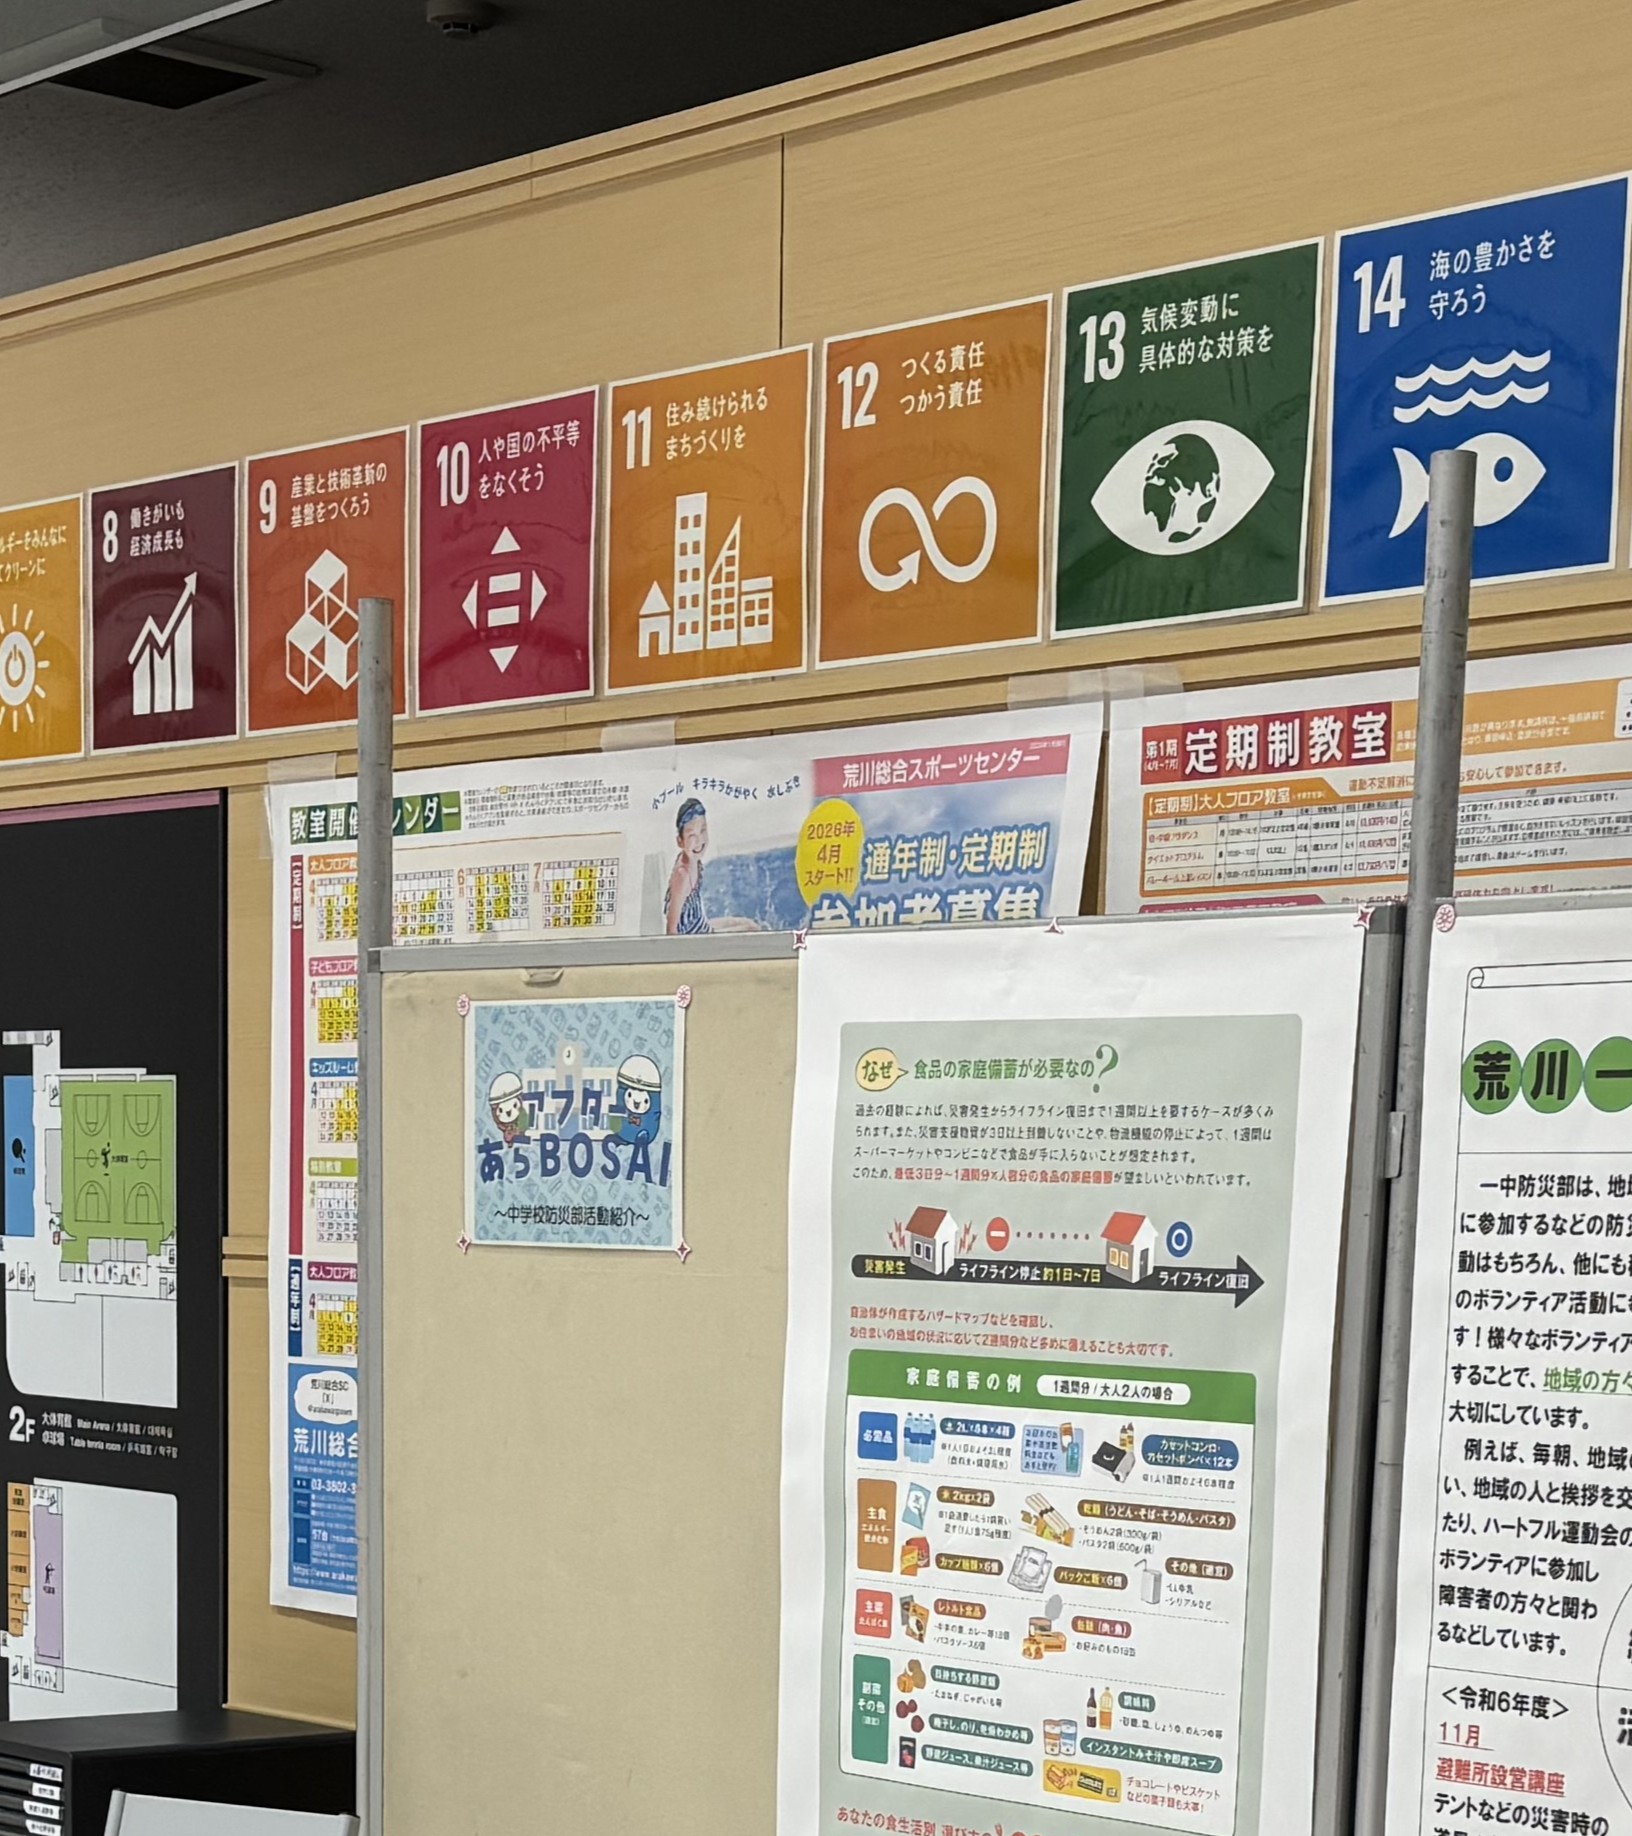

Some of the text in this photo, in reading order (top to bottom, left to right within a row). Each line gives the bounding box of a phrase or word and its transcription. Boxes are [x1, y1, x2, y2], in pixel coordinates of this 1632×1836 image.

[1429, 229, 1557, 281] 海の豊かさを
[1353, 255, 1406, 334] 14
[1428, 285, 1487, 320] 守ろう
[1140, 292, 1240, 336] 気候変動に
[902, 341, 986, 379] つくる責任
[1079, 310, 1126, 383] 13
[1139, 326, 1275, 372] 具体的な対策を
[665, 386, 769, 427] 住み続けられる
[837, 362, 878, 429] 12
[899, 379, 984, 416] つかう責任
[477, 420, 581, 464] 人や国の不平等
[621, 406, 651, 469] 11
[665, 424, 747, 460] まちづくりを
[290, 462, 388, 500] 産業と技術革新の
[437, 442, 470, 507] 10
[478, 463, 545, 499] をなくそう
[129, 500, 186, 530] 働きがいも
[259, 479, 276, 534] 9
[290, 493, 370, 529] 基盤をつくろう
[101, 510, 119, 563] 8
[129, 528, 185, 558] 経済成長も
[1146, 740, 1178, 759] 第1期
[1185, 711, 1387, 775] 定期制教室
[842, 751, 1040, 790] 荒川総合スポーツセンター
[808, 821, 856, 842] 2026年
[817, 844, 843, 863] 4月
[864, 824, 1047, 882] 通年制・定期制
[861, 1059, 895, 1081] なぜ
[914, 1044, 1118, 1093] 食品の家庭備蓄が必要なの？
[522, 1090, 627, 1129] アフター
[864, 1258, 907, 1277] 災害発生
[959, 1262, 1041, 1283] ライフライン停止
[1158, 1270, 1249, 1291] ライフライン復旧
[906, 1366, 1022, 1394] 家庭備蓄の例
[9, 1406, 35, 1442] 2F
[1448, 1400, 1591, 1432] 大切にしています。
[1438, 1549, 1600, 1583] ボランティアに参加し
[1438, 1584, 1599, 1621] 障害者の方々と関わ
[1437, 1621, 1569, 1657] るなどしています。
[1436, 1761, 1566, 1796] 避難所設営講座
